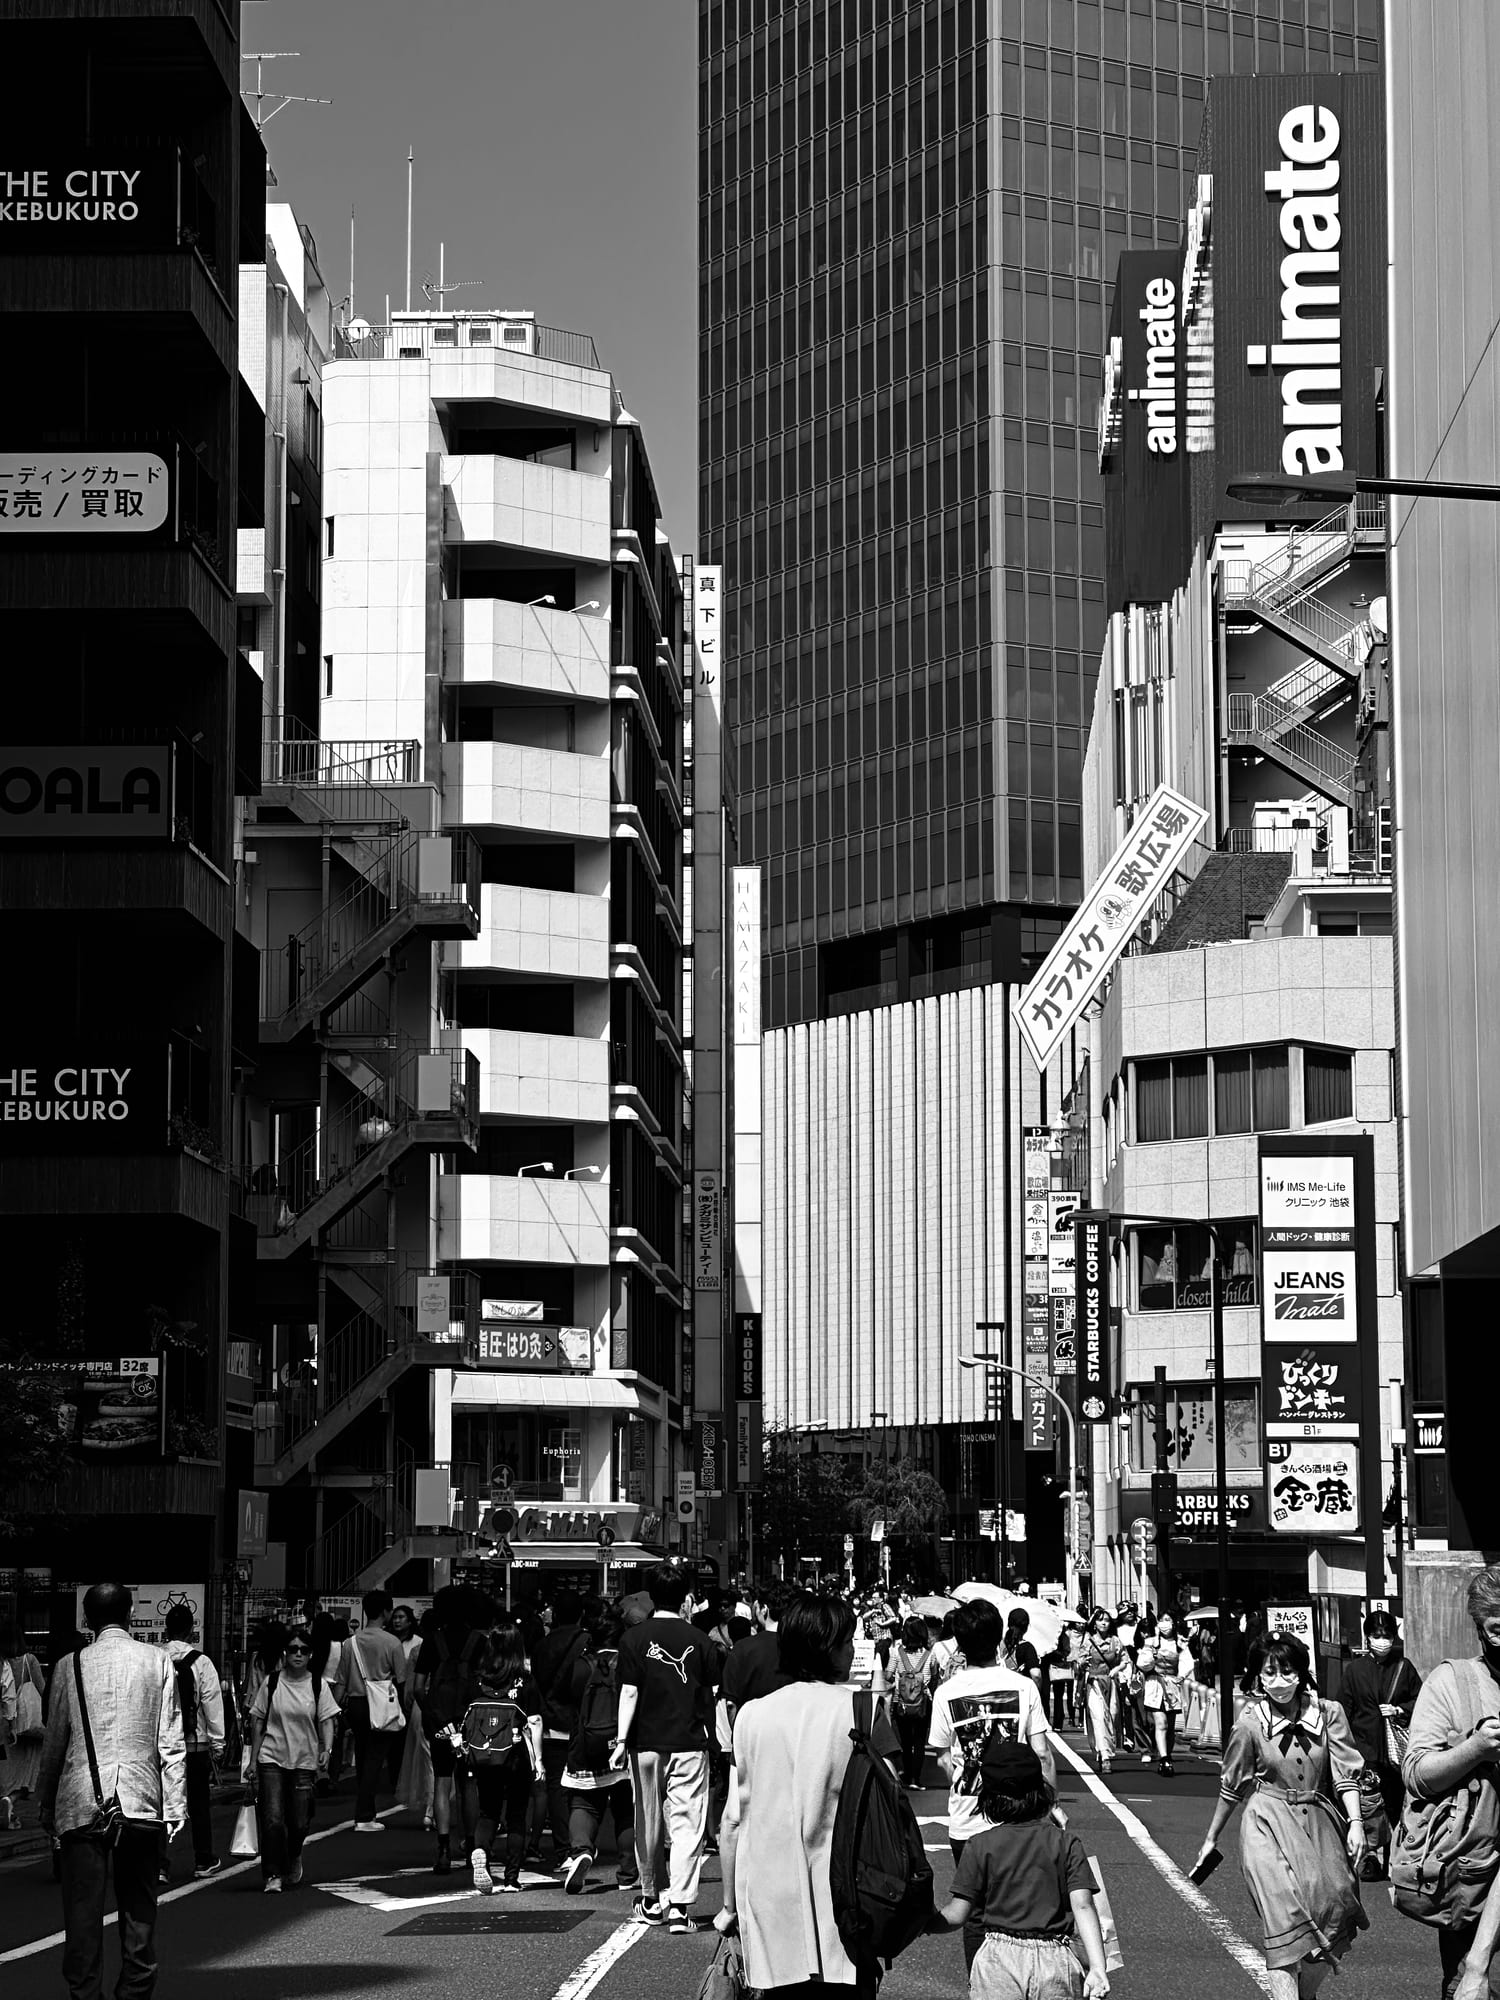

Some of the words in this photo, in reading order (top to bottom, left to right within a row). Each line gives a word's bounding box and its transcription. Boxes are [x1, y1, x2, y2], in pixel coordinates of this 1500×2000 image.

[65, 170, 141, 197] CITY
[0, 202, 139, 221] KEBUKURO
[1247, 104, 1344, 476] animate
[1128, 277, 1178, 455] animate
[0, 465, 162, 485] ーディングカード
[699, 575, 716, 687] 真下ビル
[0, 766, 161, 815] OALA
[1032, 924, 1107, 1031] カラオケ
[1114, 803, 1190, 897] 歌広場
[736, 881, 751, 1035] HAMAZAKI
[54, 1068, 132, 1096] CITY
[0, 1100, 129, 1121] EBUKURO
[1287, 1182, 1306, 1192] IMS
[1308, 1181, 1346, 1192] Me-Life
[1285, 1197, 1327, 1208] クリニック
[1329, 1197, 1350, 1208] 池袋
[1087, 1224, 1100, 1283] COFFEE
[1274, 1271, 1345, 1289] JEANS
[1177, 1284, 1212, 1307] closet
[1275, 1293, 1345, 1320] mate
[1087, 1286, 1100, 1383] STARBUCKS
[743, 1319, 754, 1395] K-BOOKS
[1281, 1358, 1339, 1387] びっくり
[1278, 1385, 1346, 1410] ドンキー
[1031, 1400, 1046, 1446] ガスト
[1278, 1411, 1346, 1419] ハンバーグレストラン
[739, 1416, 749, 1467] FamilyMart
[1269, 1443, 1288, 1457] B1
[1280, 1464, 1332, 1474] きんくら酒場
[1176, 1494, 1250, 1510] ARBUKS
[1273, 1475, 1353, 1515] 金の蔵
[479, 1507, 618, 1542] AC-MART
[511, 1560, 539, 1568] ABC-MART
[610, 1560, 637, 1569] ABC-MART
[1274, 1611, 1307, 1622] きんくら
